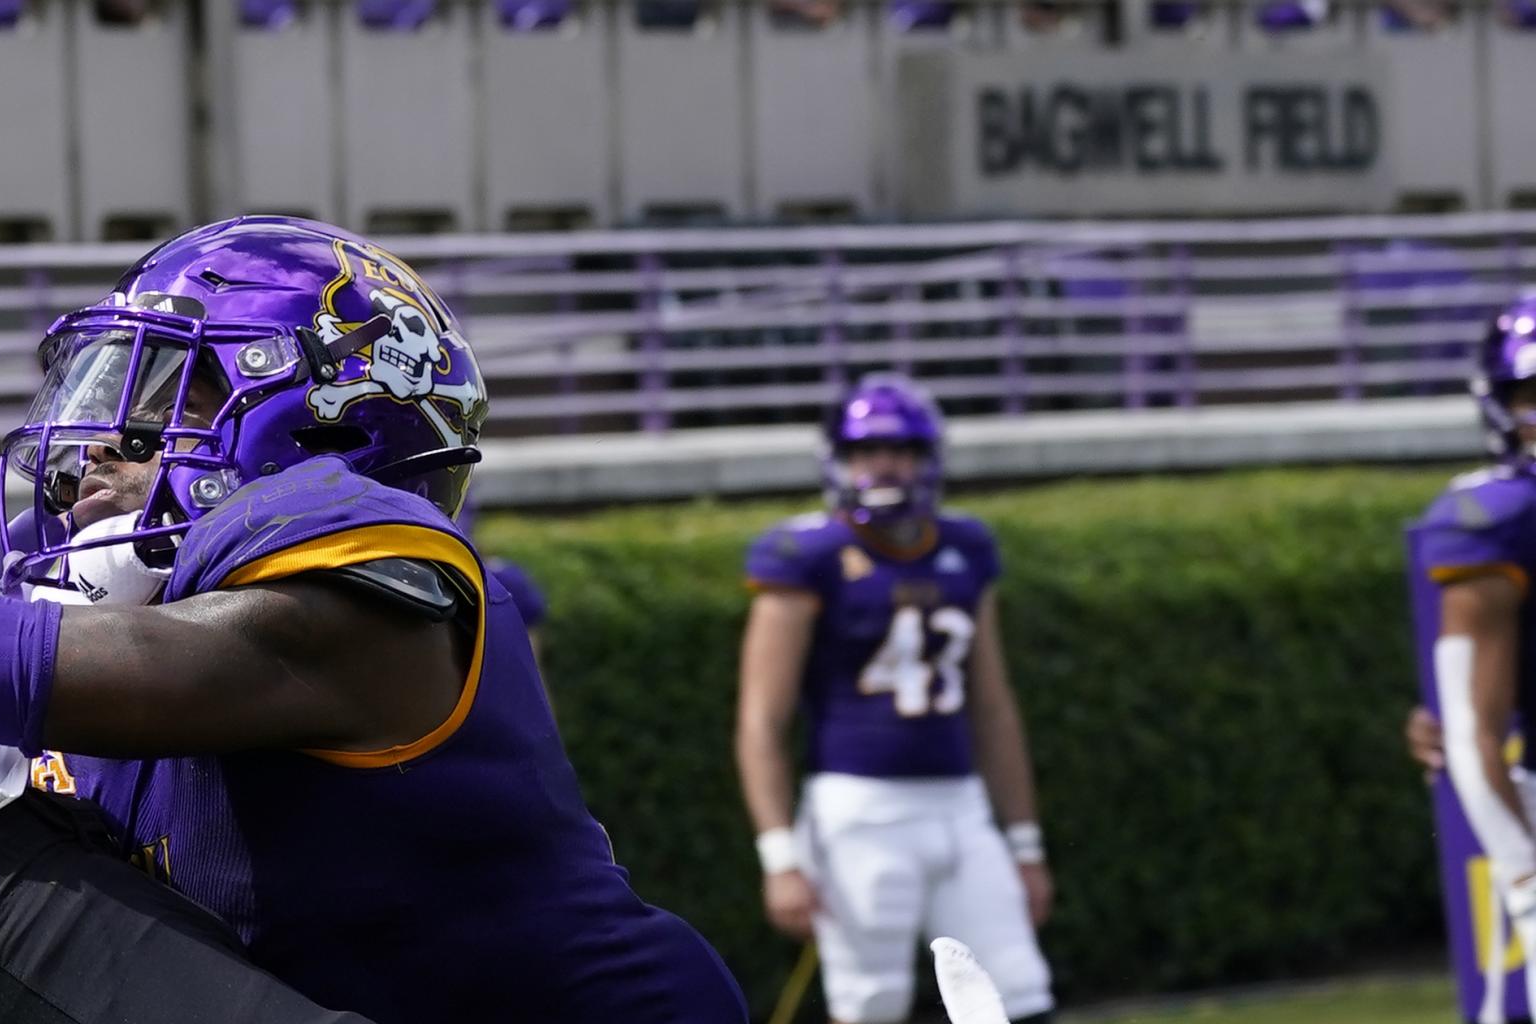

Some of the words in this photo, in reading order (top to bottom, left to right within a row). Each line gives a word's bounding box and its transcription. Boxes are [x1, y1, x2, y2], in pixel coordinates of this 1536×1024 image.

[976, 84, 1224, 177] BAGWELL
[1244, 83, 1382, 174] FIELD
[858, 605, 975, 717] 43
